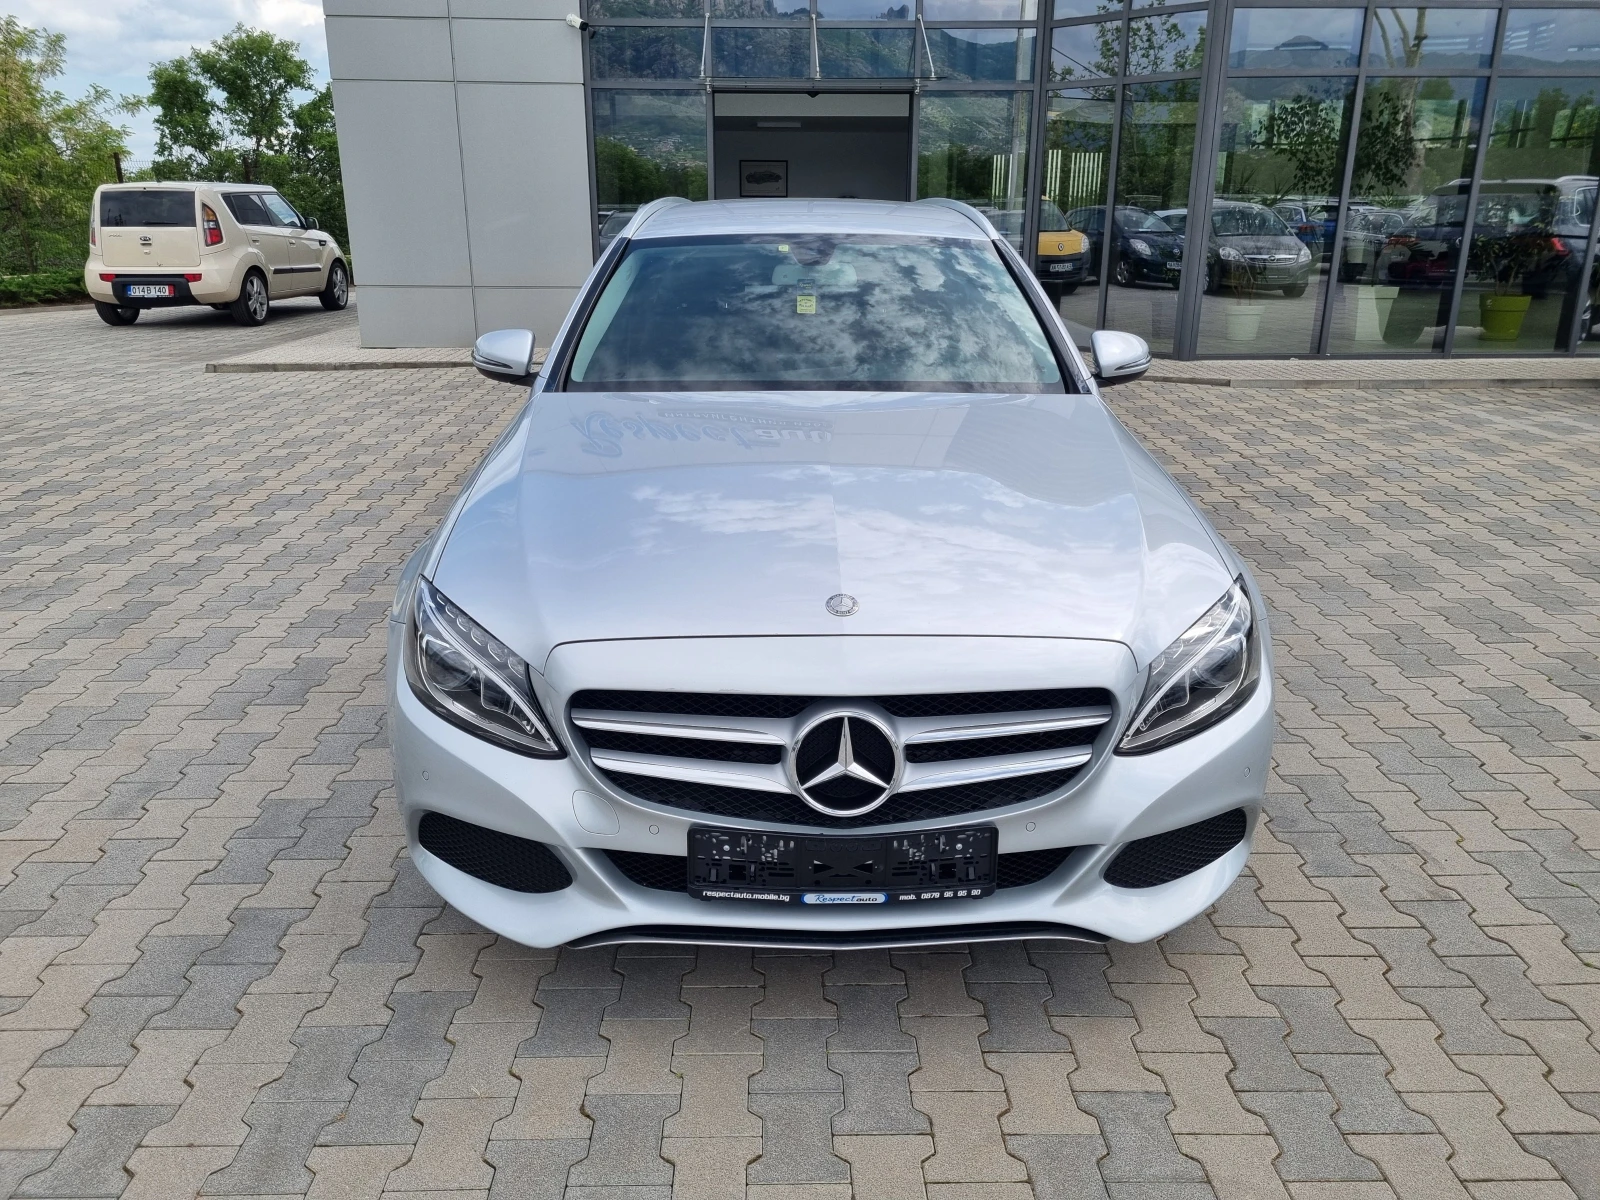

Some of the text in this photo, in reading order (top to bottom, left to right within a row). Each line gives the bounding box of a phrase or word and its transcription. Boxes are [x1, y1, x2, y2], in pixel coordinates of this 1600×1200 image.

[154, 286, 167, 295] 140
[702, 889, 790, 902] respectauto.mobile.bg
[921, 892, 940, 900] 0879
[944, 890, 954, 898] 95
[957, 889, 967, 897] 95
[971, 888, 981, 896] 90
